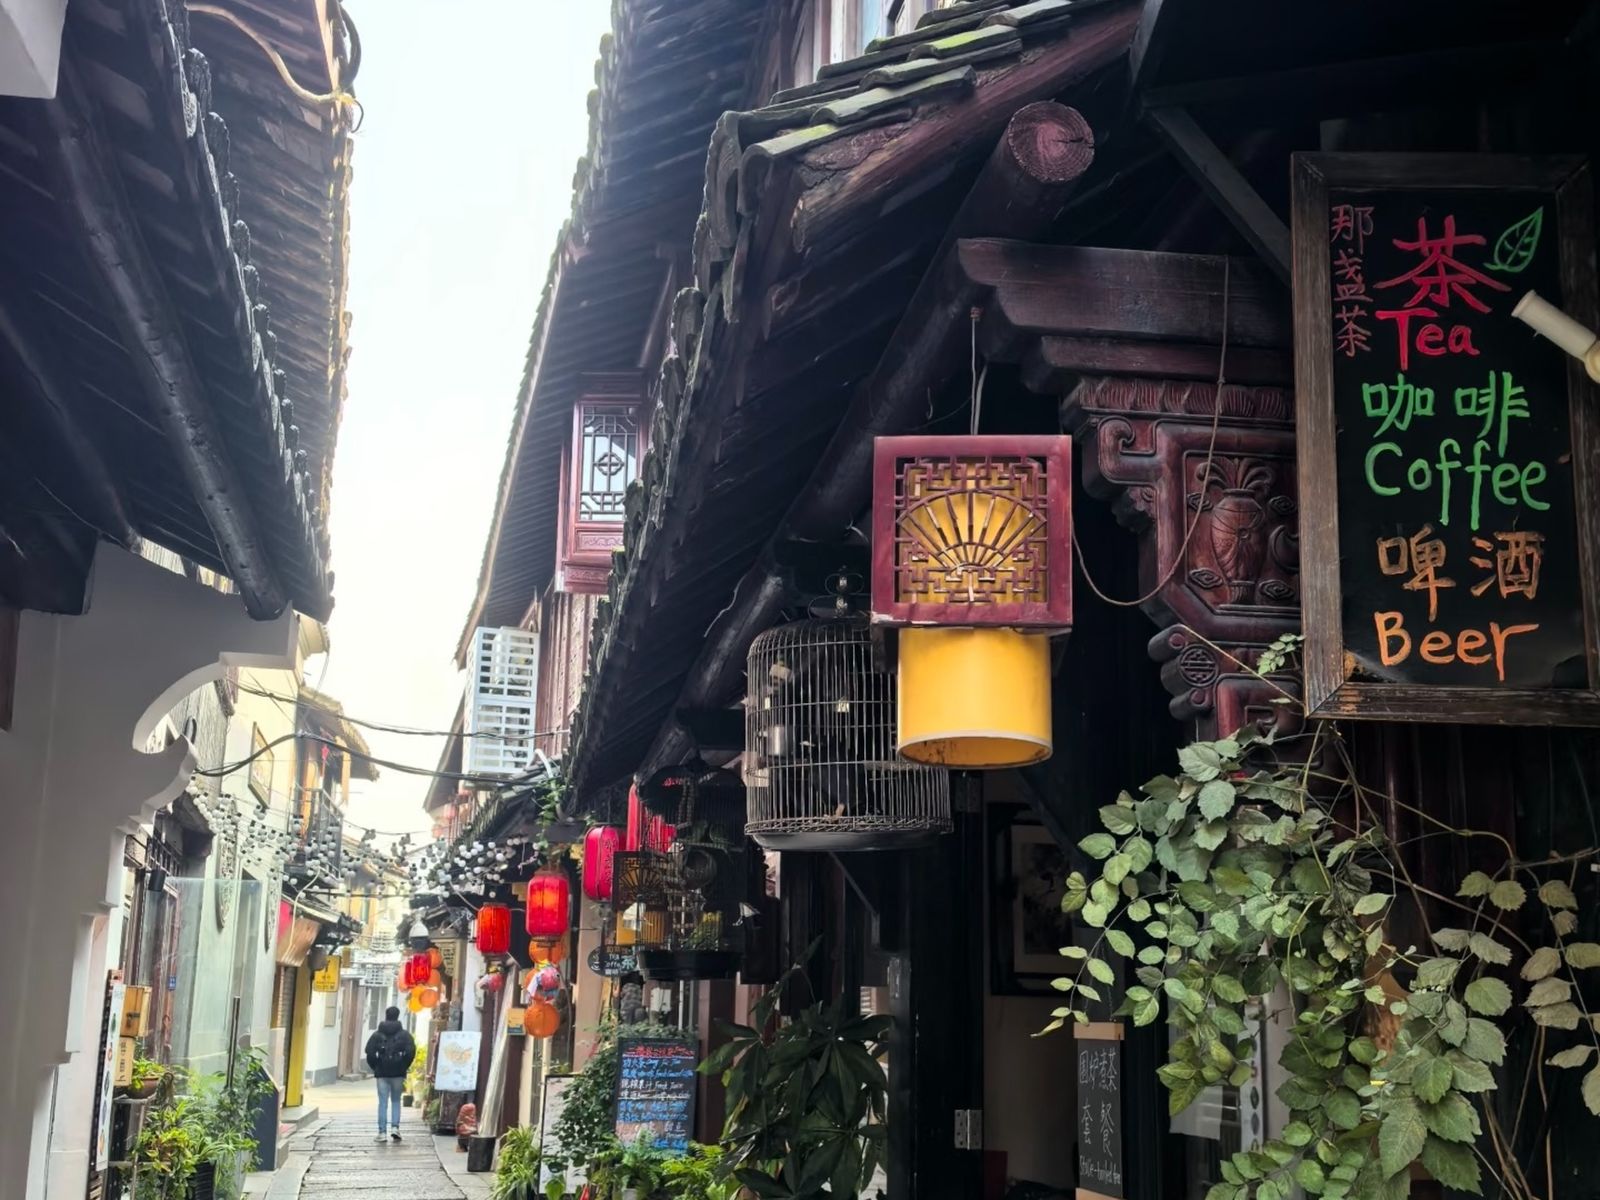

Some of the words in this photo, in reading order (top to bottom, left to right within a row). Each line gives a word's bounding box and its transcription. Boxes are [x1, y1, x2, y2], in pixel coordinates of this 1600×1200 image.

[1373, 214, 1512, 314] 茶
[1375, 307, 1480, 370] Tea
[1362, 370, 1530, 457] 咖啡
[1364, 438, 1550, 530] Coffee
[1376, 523, 1545, 622] 啤酒
[1373, 611, 1539, 681] Beer
